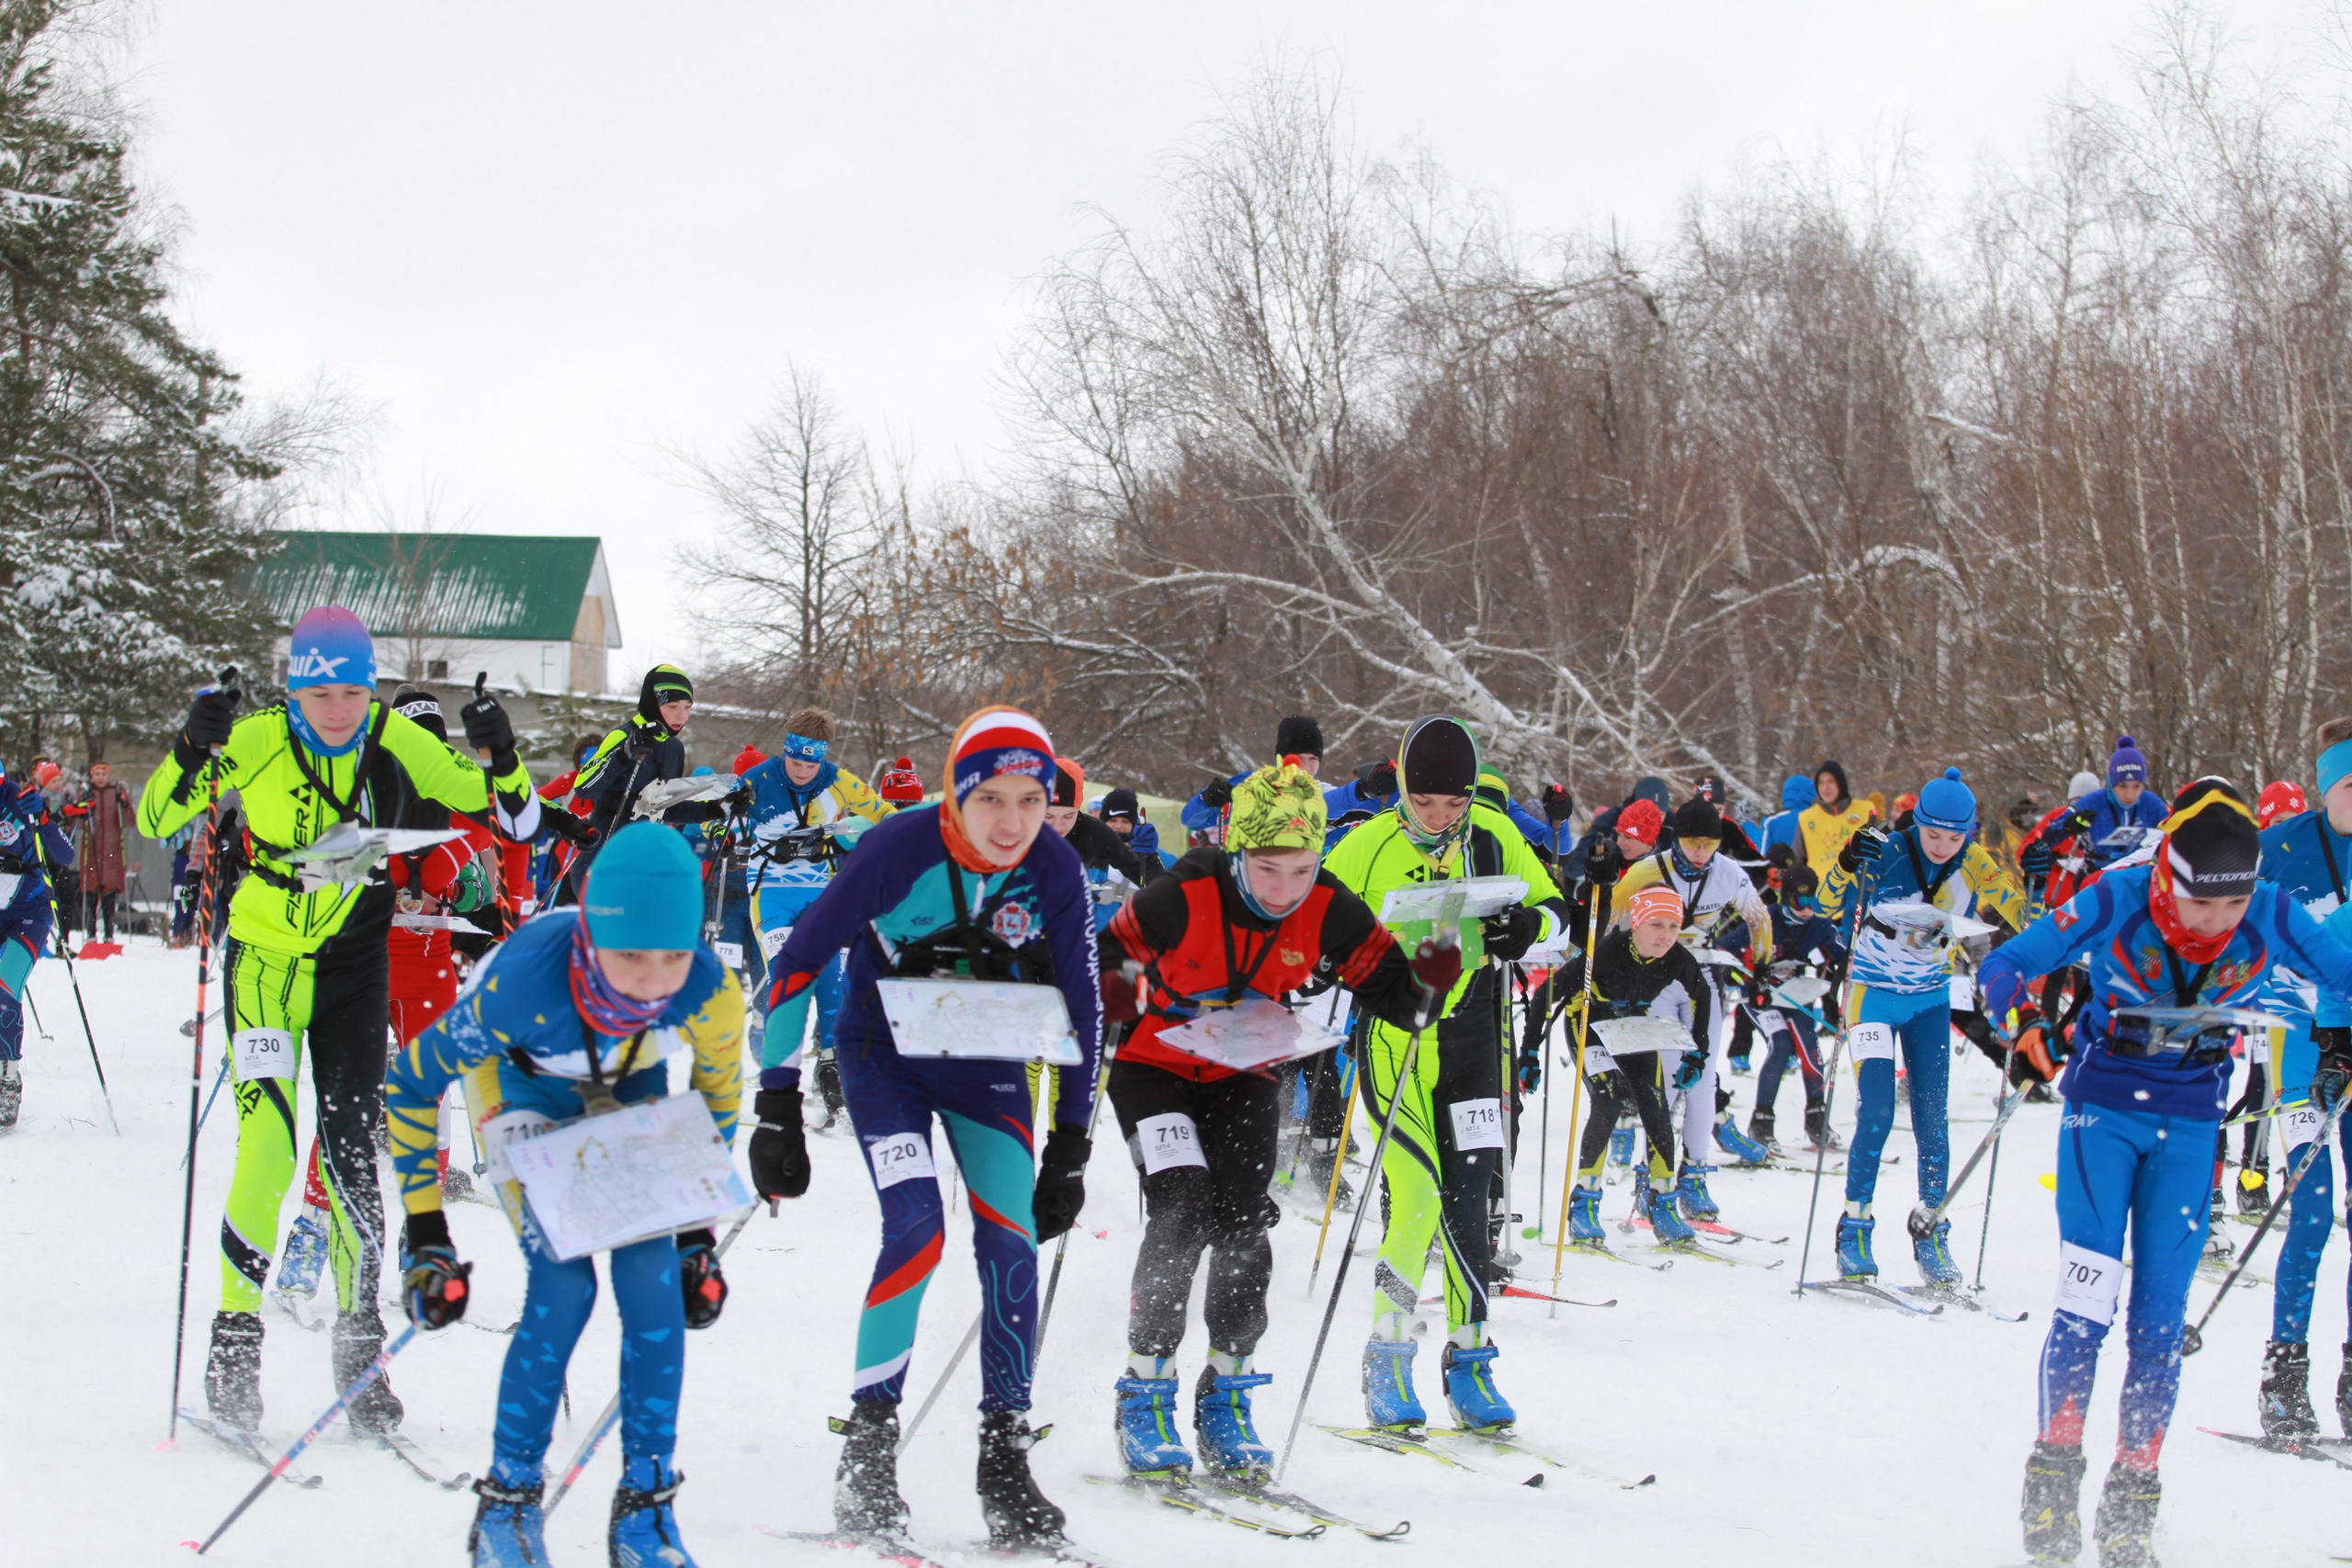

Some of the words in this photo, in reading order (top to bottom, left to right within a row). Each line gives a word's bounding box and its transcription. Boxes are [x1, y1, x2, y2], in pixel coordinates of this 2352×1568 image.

[768, 932, 786, 944] 758
[719, 947, 733, 955] 778
[1859, 1032, 1880, 1043] 735
[248, 1038, 280, 1054] 730
[1467, 1108, 1495, 1124] 718
[2289, 1111, 2316, 1126] 726
[1156, 1125, 1190, 1143] 719
[879, 1143, 917, 1166] 720
[2067, 1261, 2103, 1286] 707
